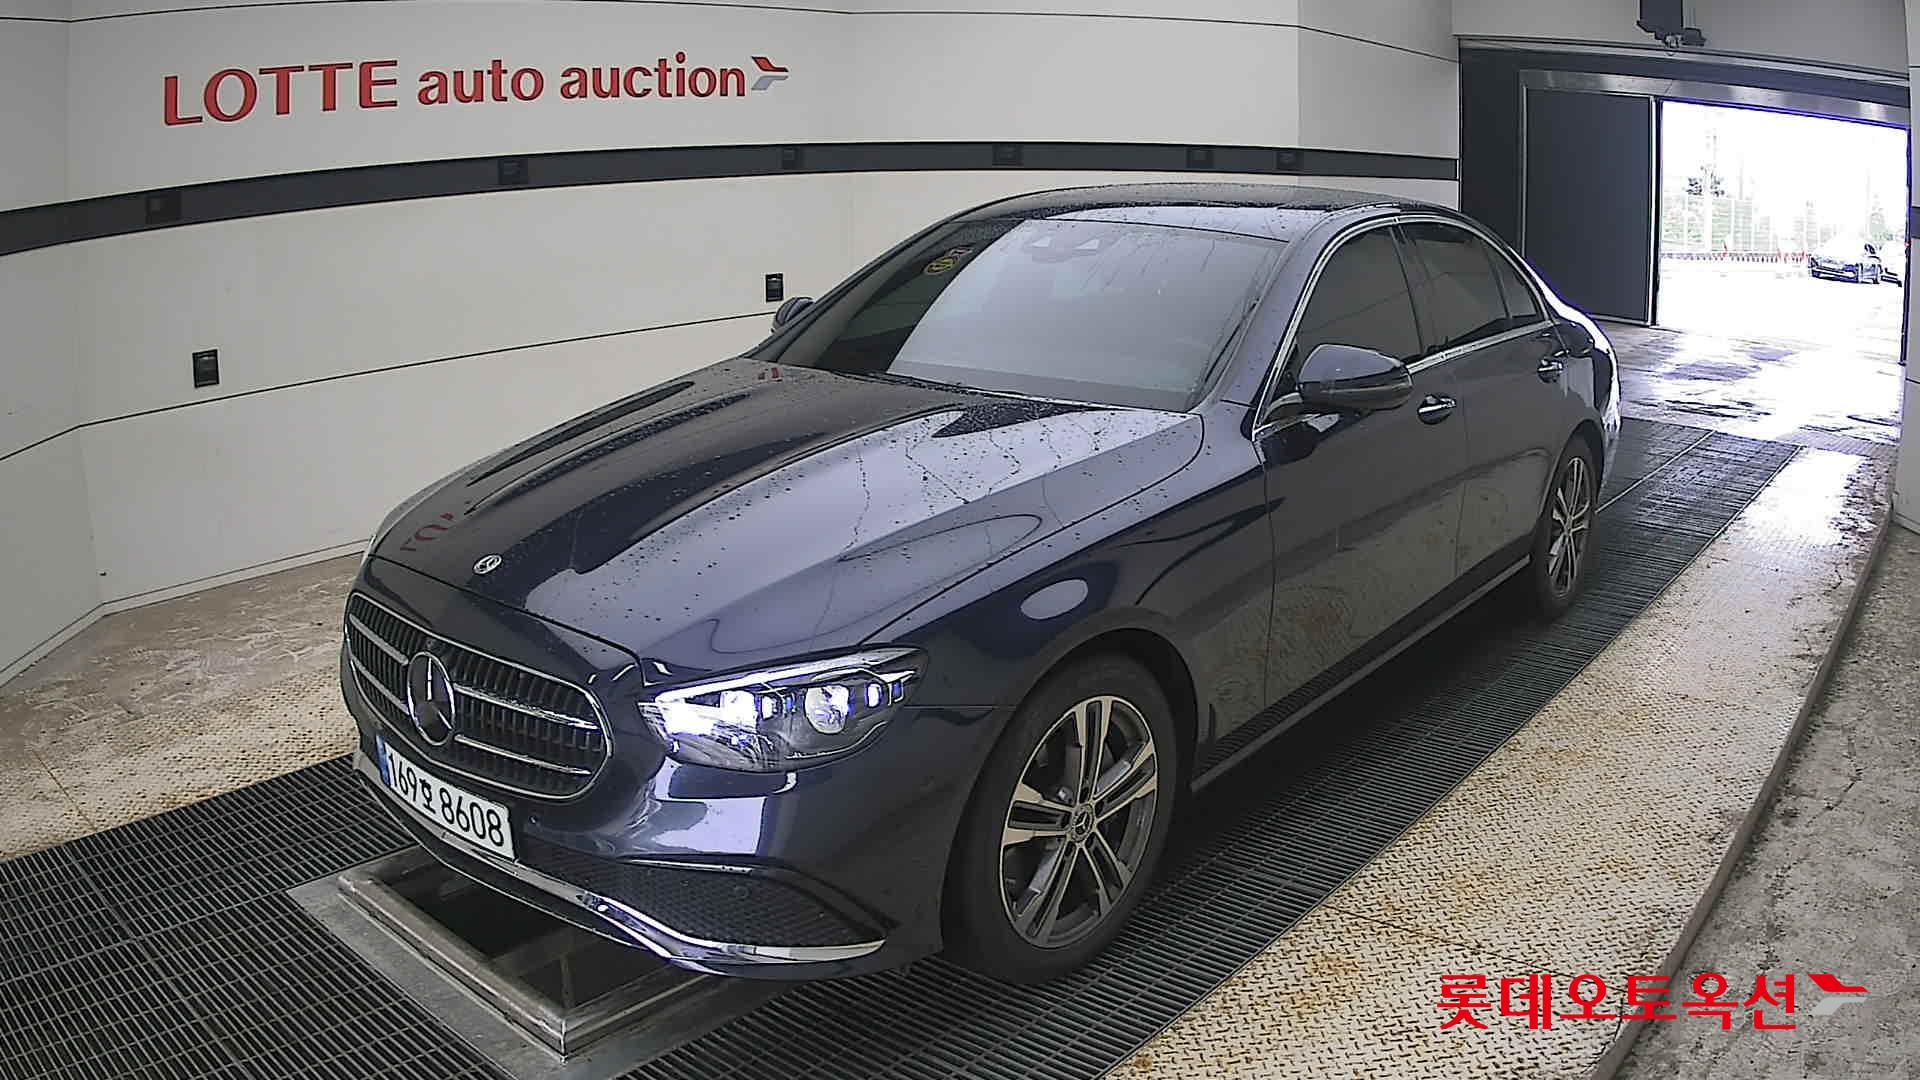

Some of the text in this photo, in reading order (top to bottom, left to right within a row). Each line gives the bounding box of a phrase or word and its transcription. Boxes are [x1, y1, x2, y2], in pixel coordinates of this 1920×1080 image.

[163, 51, 747, 127] LOTTE auto auction
[439, 786, 505, 848] 8608
